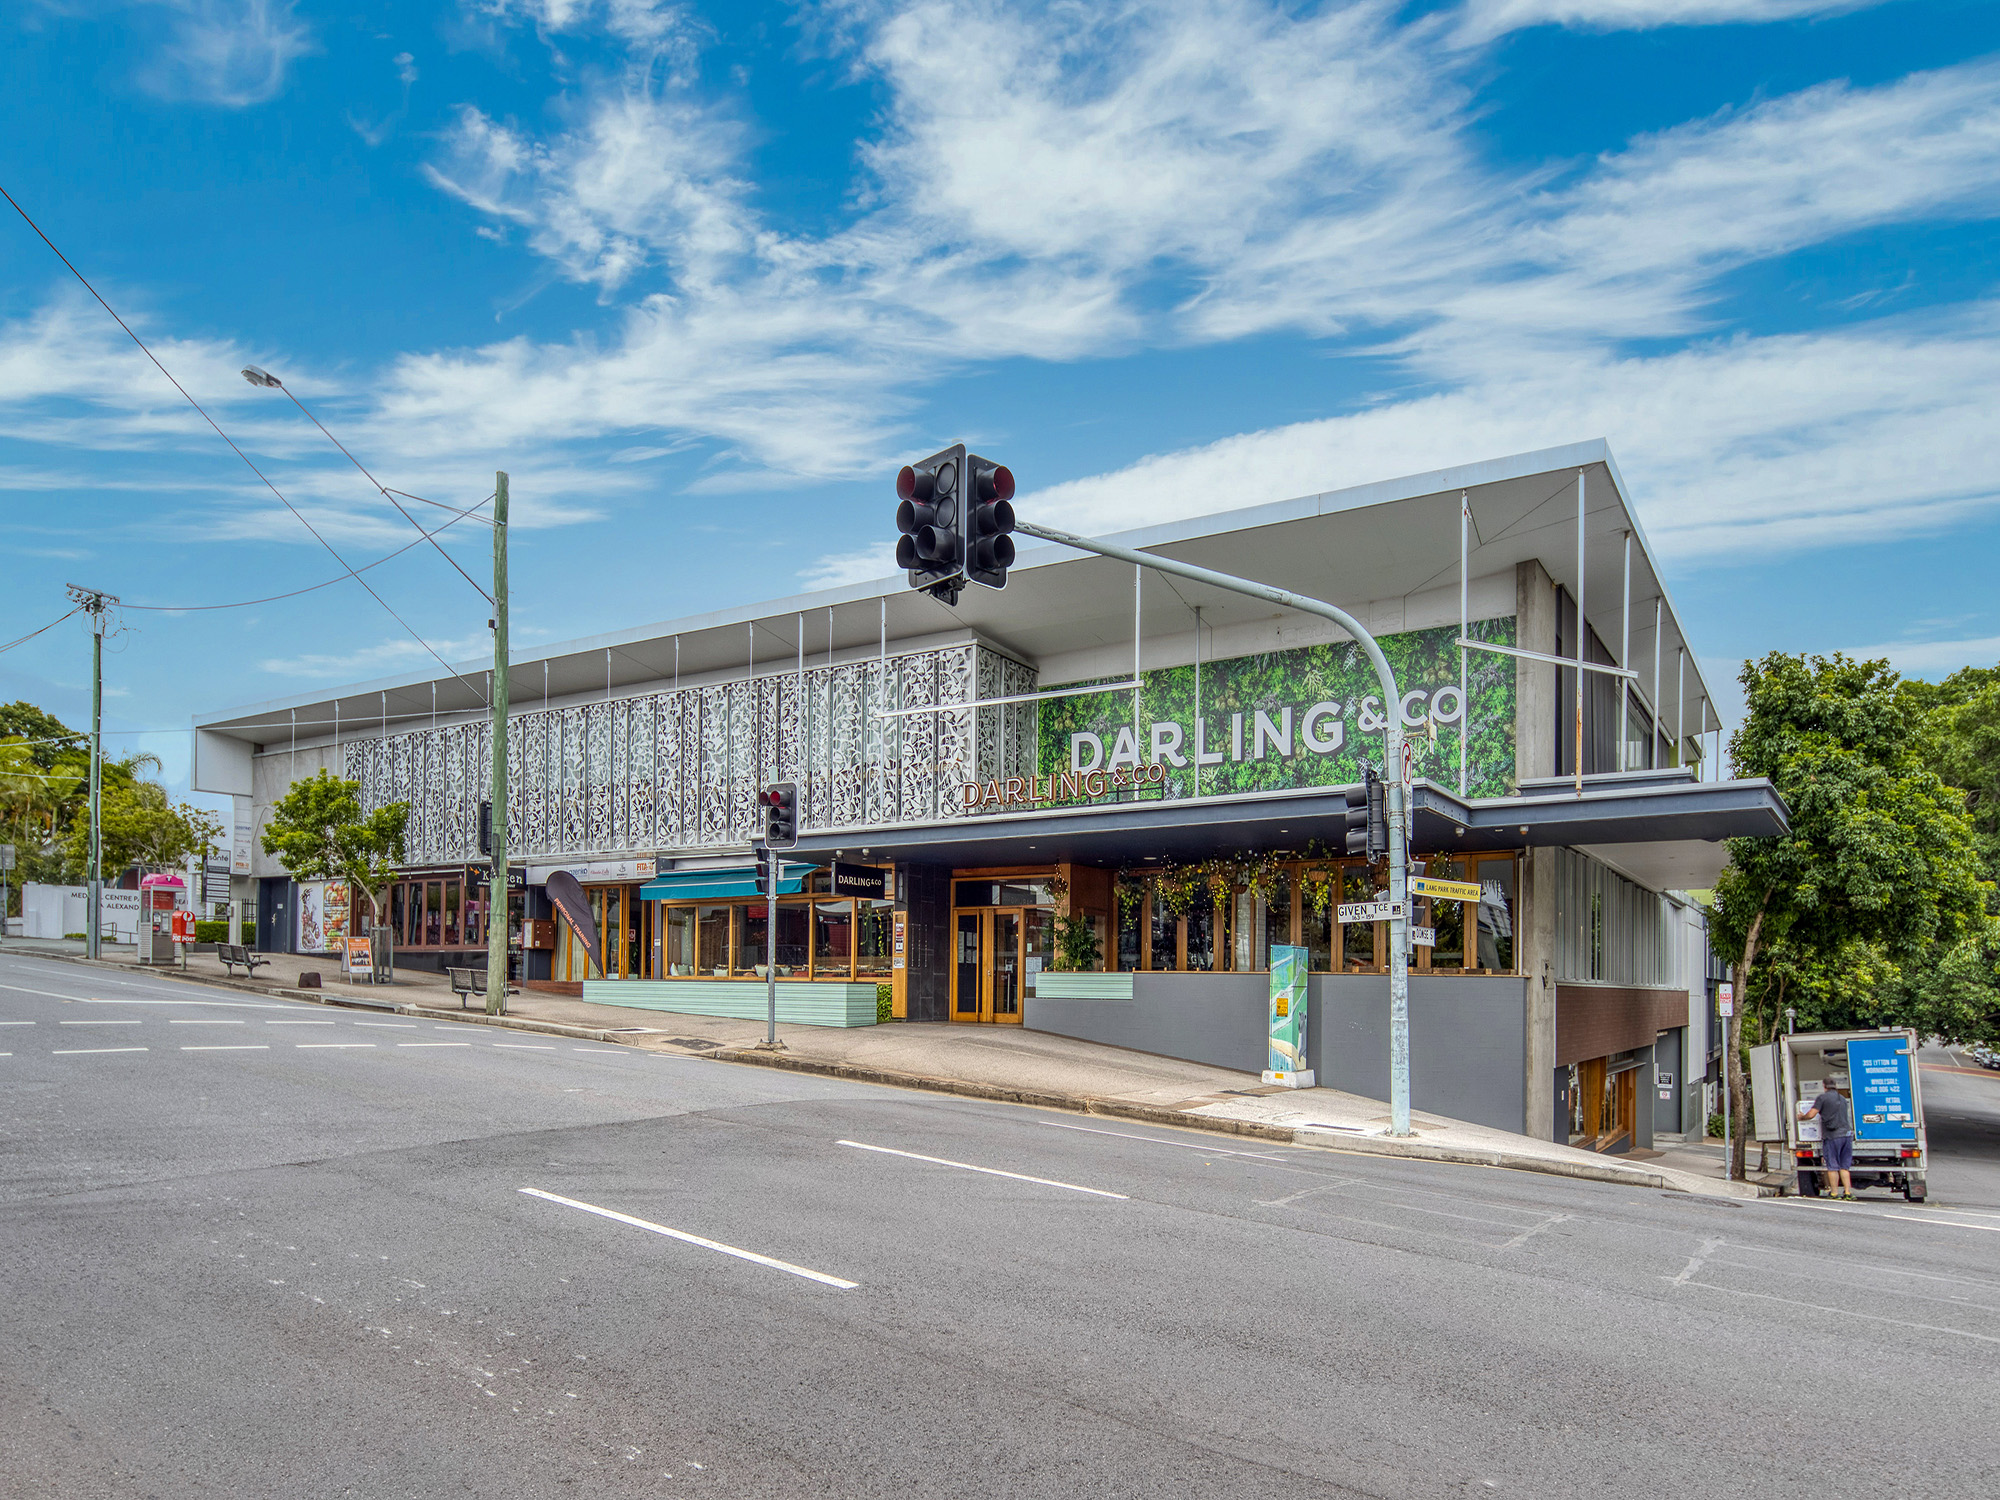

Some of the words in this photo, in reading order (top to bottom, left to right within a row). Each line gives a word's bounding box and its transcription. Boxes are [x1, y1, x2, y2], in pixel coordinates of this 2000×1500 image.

[1071, 702, 1345, 776] DARLING
[962, 769, 1107, 809] DARLING
[105, 894, 131, 902] CENTRE
[1450, 887, 1466, 895] TRAFFIC
[554, 898, 574, 925] PERSONAL
[573, 924, 591, 948] TRAINING
[1338, 905, 1367, 917] GIVEN
[1373, 903, 1388, 914] TCE
